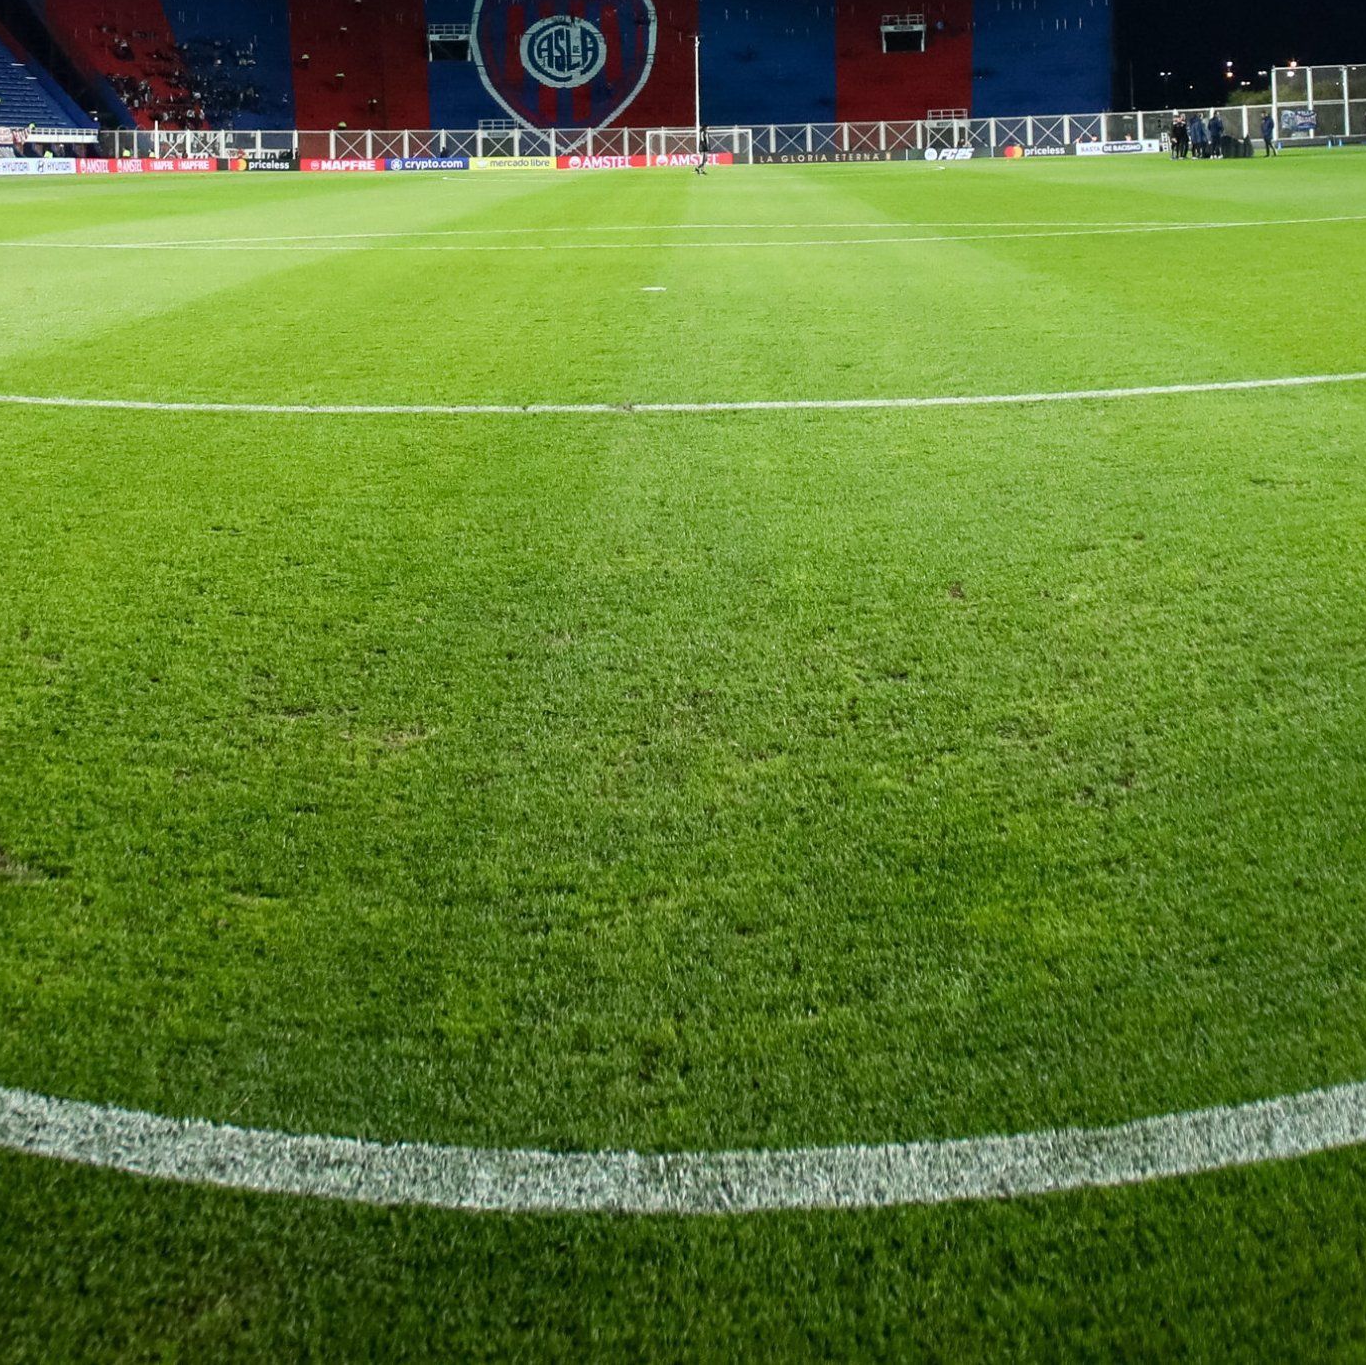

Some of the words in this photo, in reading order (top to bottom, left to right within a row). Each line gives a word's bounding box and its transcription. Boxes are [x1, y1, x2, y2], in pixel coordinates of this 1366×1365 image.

[1024, 145, 1066, 156] priceless
[1103, 144, 1113, 152] DE
[759, 155, 774, 163] LA
[781, 154, 828, 163] GLORIA
[835, 153, 880, 162] ETERNA
[938, 148, 974, 160] FC25
[86, 159, 109, 173] AMSTEL
[121, 159, 143, 172] AMSTEL
[181, 160, 210, 170] MAPFRE
[248, 159, 290, 171] priceless
[321, 160, 376, 171] MAPFRE
[404, 158, 463, 170] crypto.com
[490, 158, 528, 167] mercado
[530, 158, 550, 167] libre
[584, 156, 632, 168] AMSTEL
